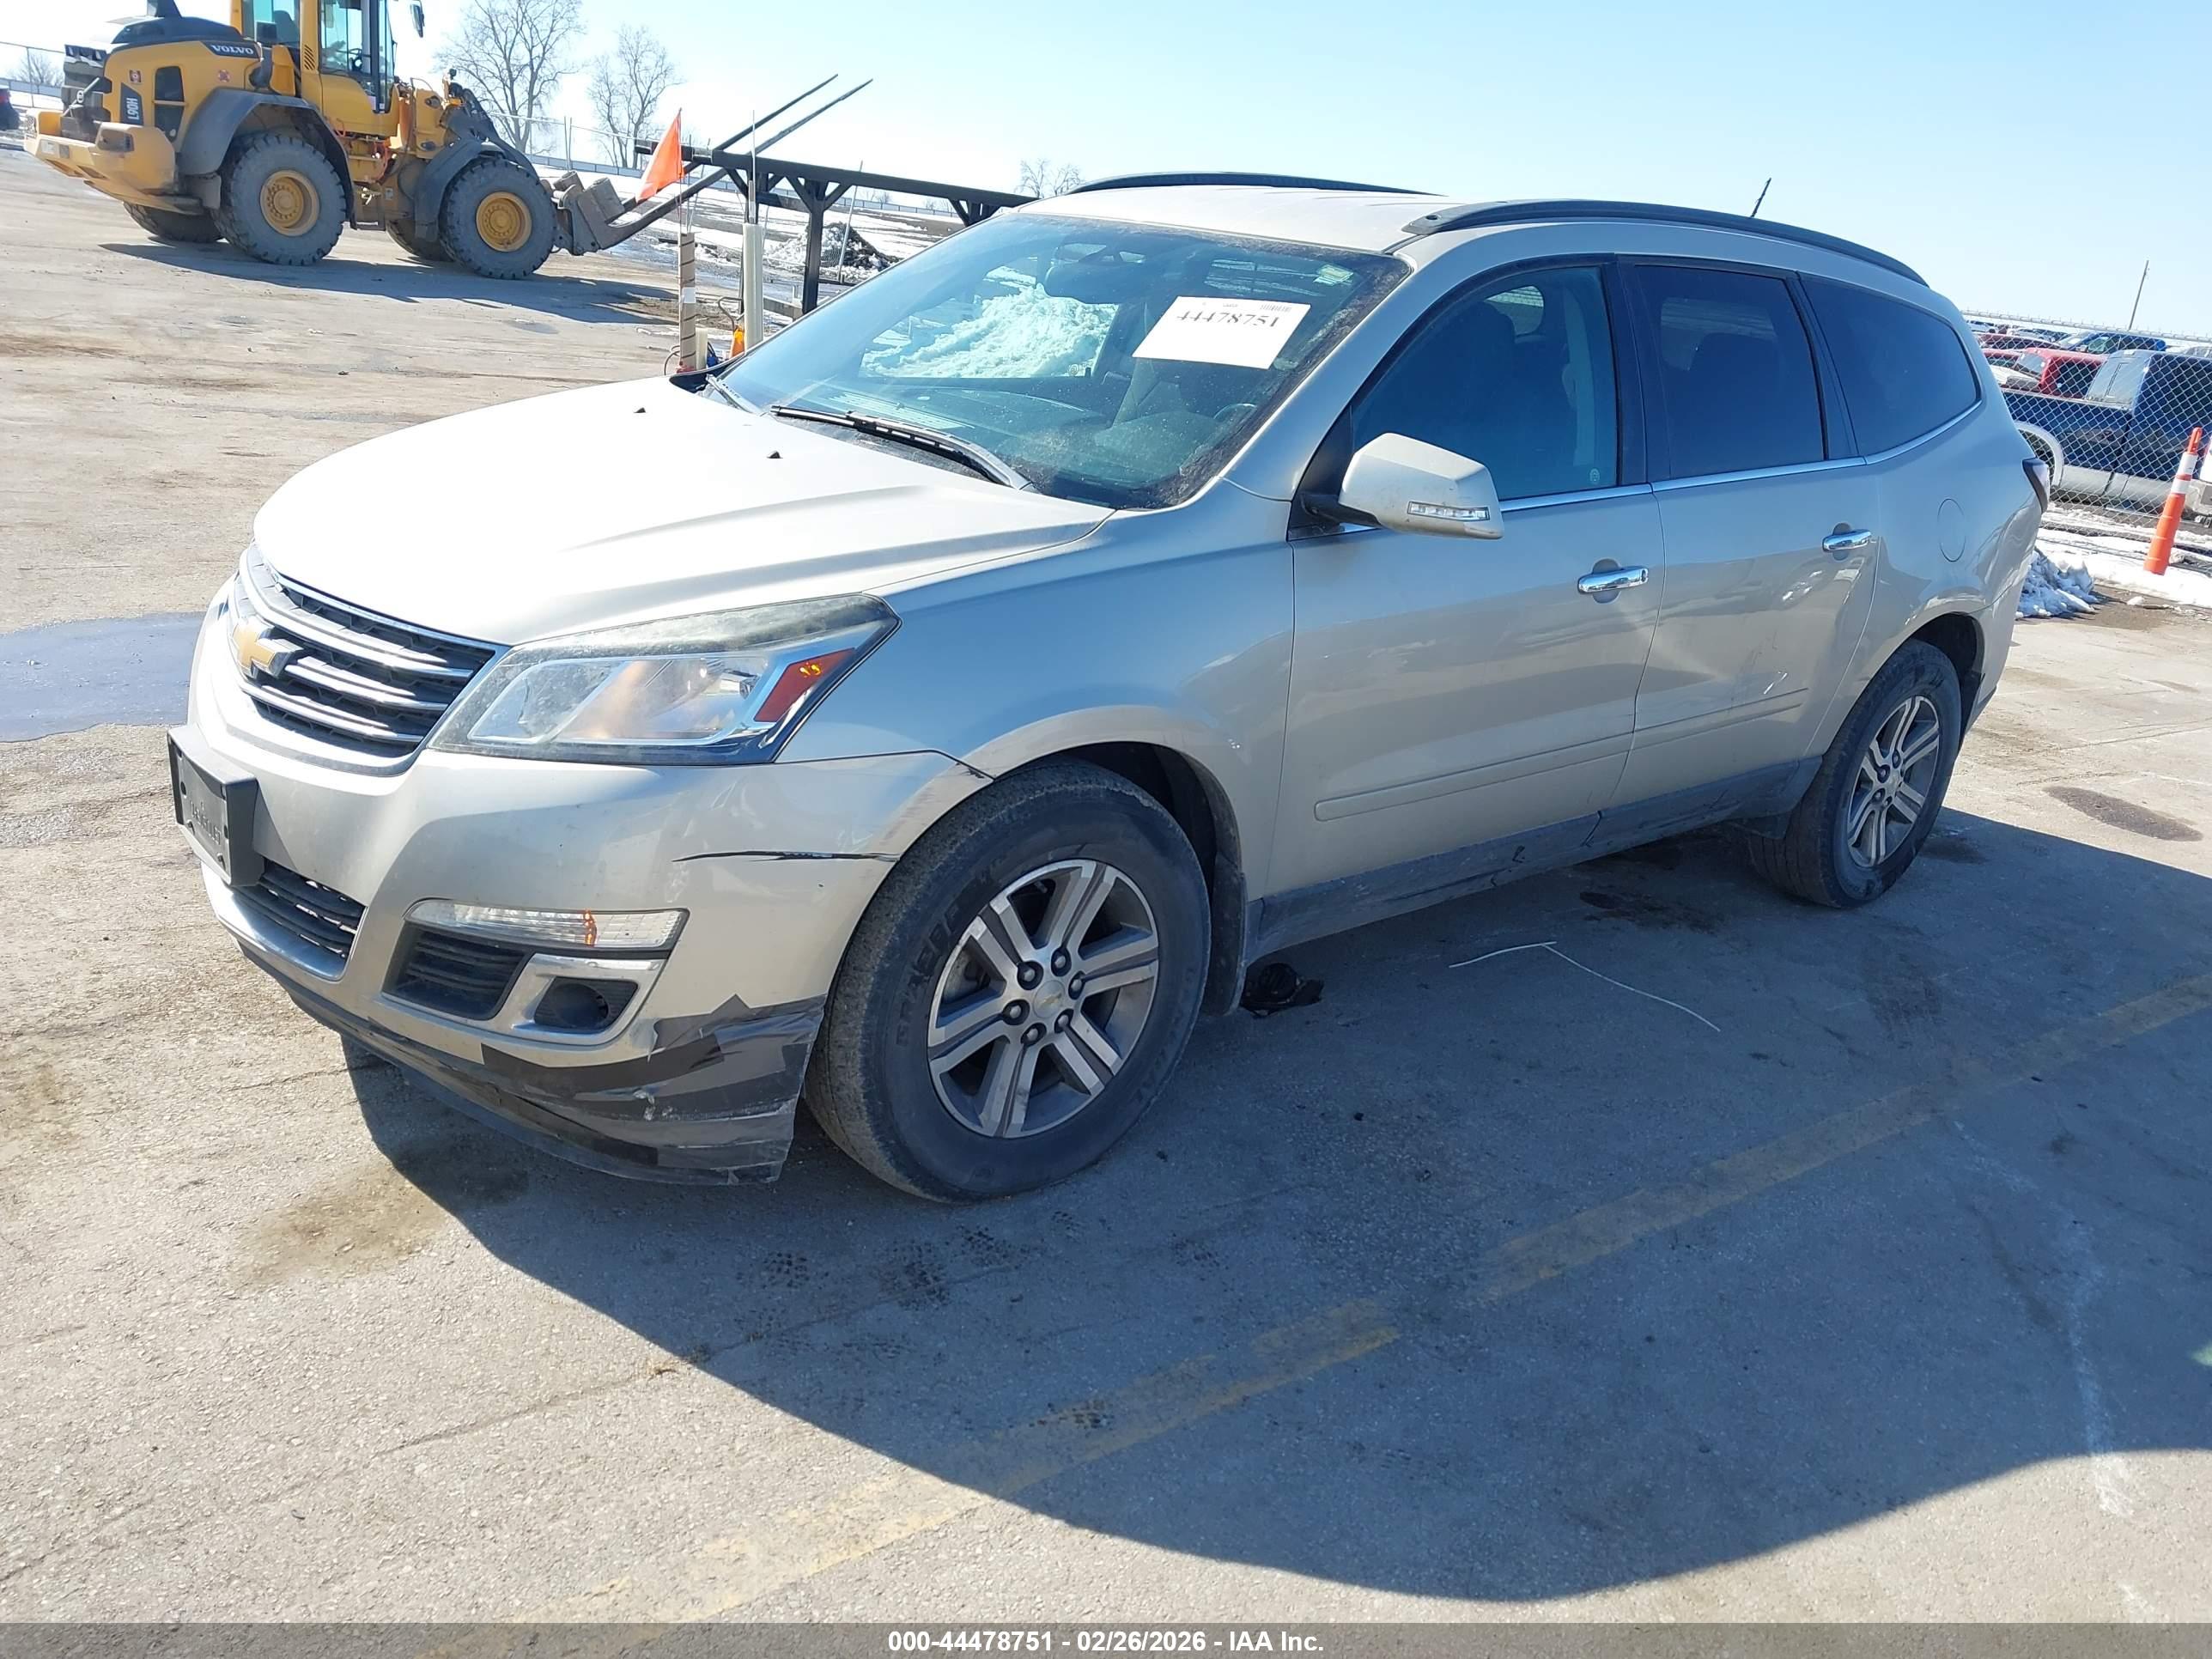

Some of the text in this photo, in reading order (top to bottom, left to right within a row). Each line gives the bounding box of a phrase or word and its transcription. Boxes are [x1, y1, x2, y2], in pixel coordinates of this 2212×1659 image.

[210, 45, 254, 55] VOLVO
[126, 97, 140, 120] L90H
[1176, 310, 1279, 327] 44478751
